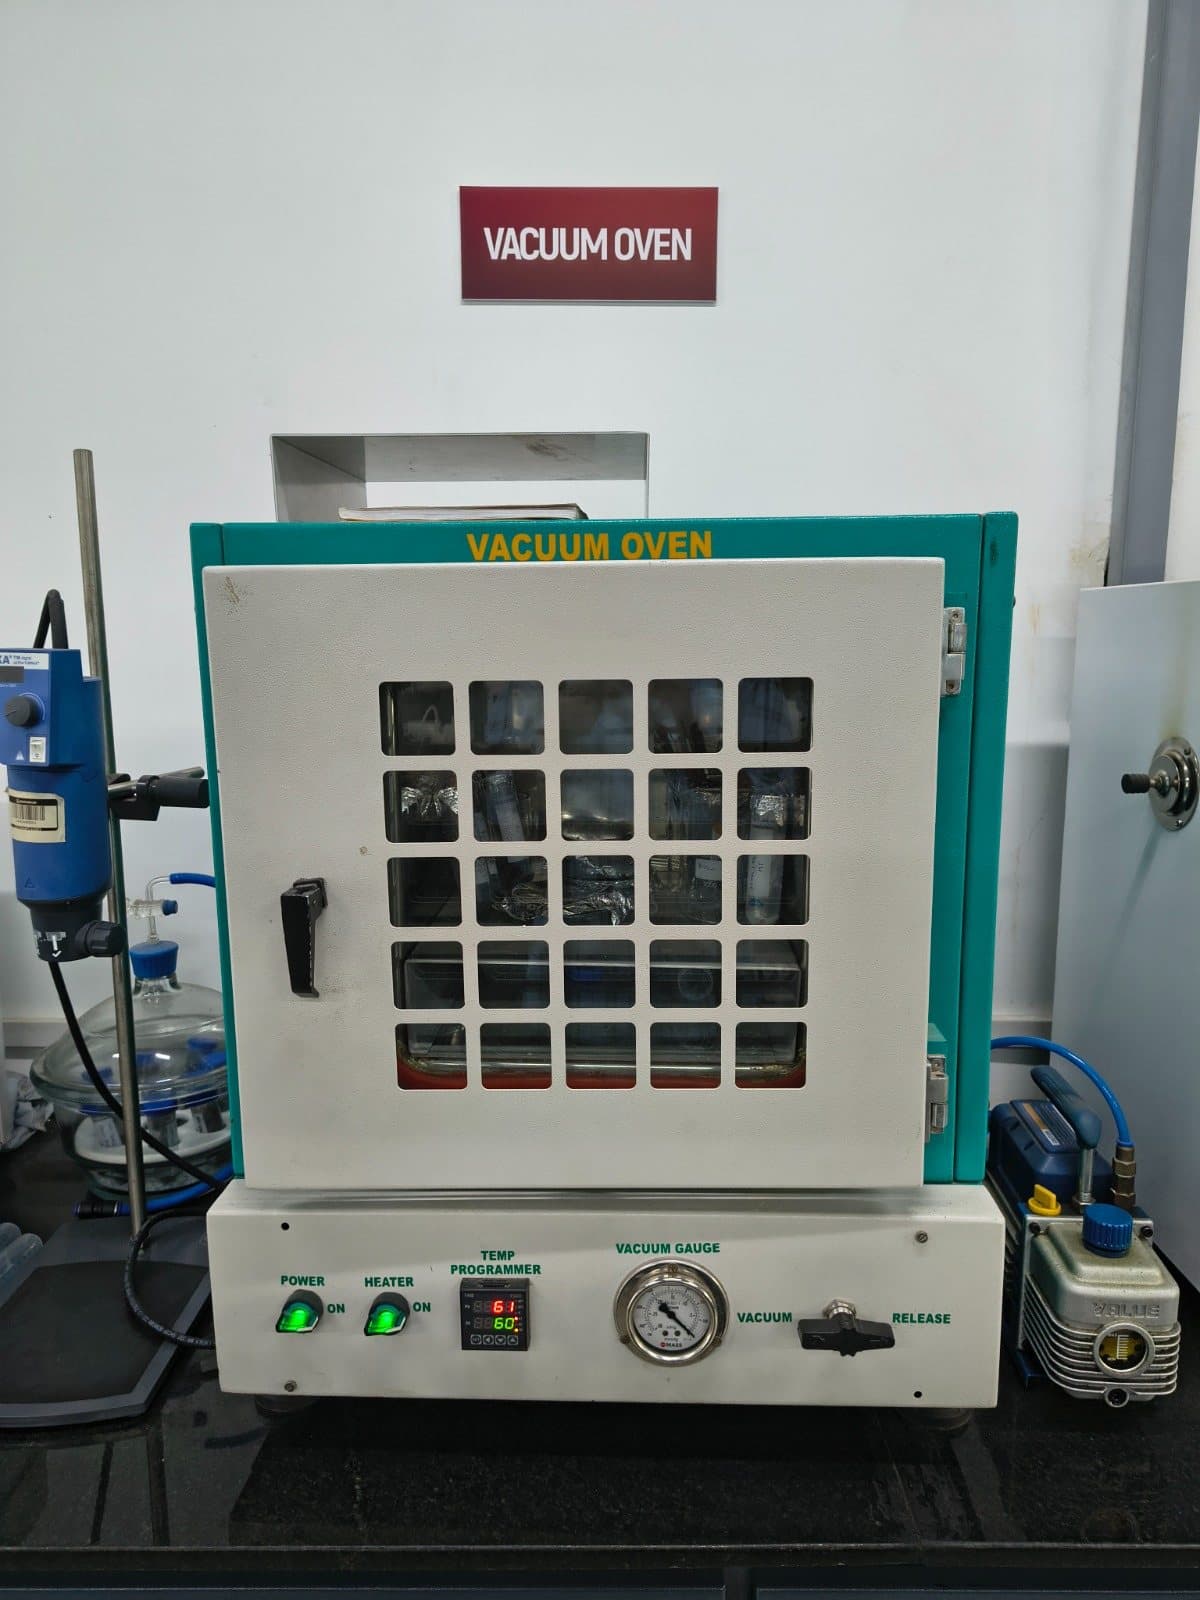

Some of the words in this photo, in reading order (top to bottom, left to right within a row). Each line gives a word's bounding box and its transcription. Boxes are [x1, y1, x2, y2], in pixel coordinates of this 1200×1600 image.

[483, 227, 608, 261] VACUUM
[614, 228, 692, 261] OVEN
[466, 532, 609, 562] VACUUM
[621, 531, 713, 559] OVEN
[615, 1243, 671, 1255] VACUUM
[675, 1242, 721, 1254] GAUGE
[480, 1250, 515, 1262] TEMP
[450, 1263, 542, 1276] PROGRAMMER
[280, 1275, 326, 1287] POWER
[364, 1276, 415, 1288] HEATER
[327, 1303, 346, 1314] ON
[412, 1302, 432, 1313] ON
[493, 1300, 515, 1313] 61
[494, 1317, 515, 1330] 60
[737, 1312, 793, 1324] VACUUM
[892, 1313, 952, 1325] RELEASE
